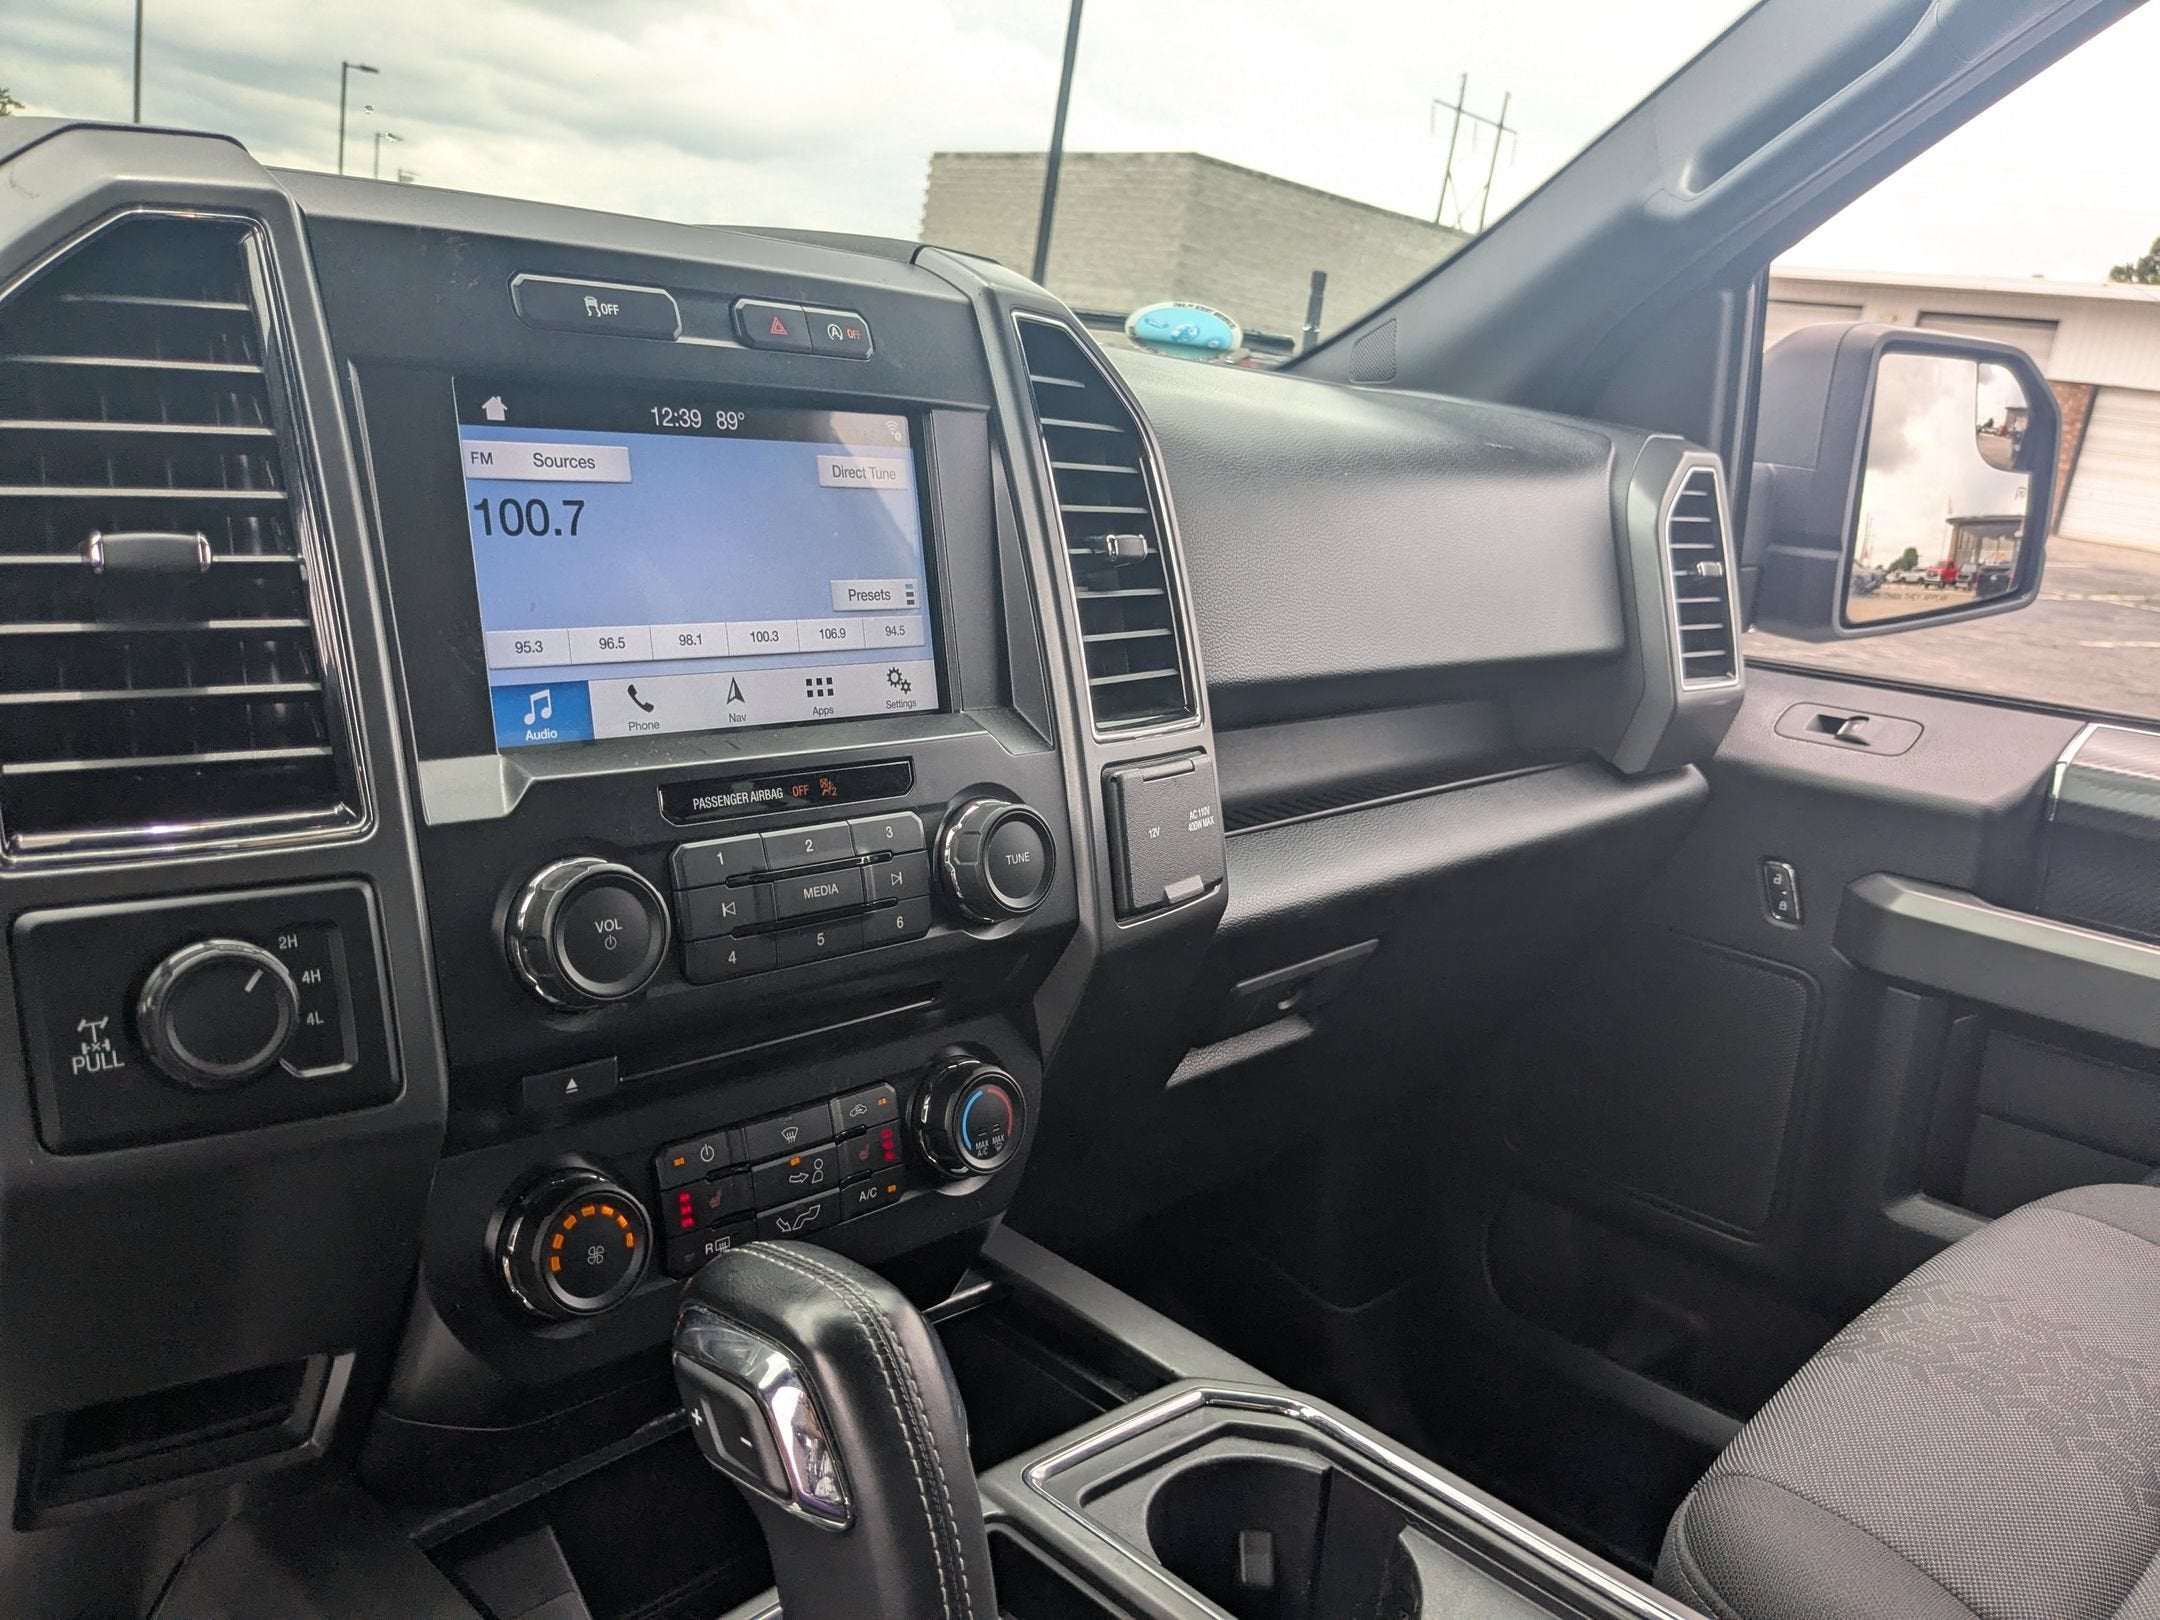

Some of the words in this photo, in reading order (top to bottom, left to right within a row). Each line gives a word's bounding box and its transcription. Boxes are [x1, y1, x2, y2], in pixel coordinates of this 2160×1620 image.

[600, 302, 619, 316] OFF
[846, 328, 862, 340] OFF
[651, 406, 702, 429] 12:39
[716, 409, 746, 431] 89°
[470, 450, 494, 466] FM
[533, 453, 596, 471] Sources
[831, 464, 867, 481] Direct
[868, 465, 897, 481] Tune
[474, 498, 585, 537] 100.7
[848, 588, 891, 604] Presets
[514, 640, 544, 655] 95.3
[599, 636, 626, 650] 96.5
[678, 633, 703, 647] 98.1
[750, 629, 780, 643] 100.3
[818, 626, 847, 640] 106.9
[885, 624, 906, 637] 94.5
[885, 696, 918, 711] Settings
[728, 712, 747, 724] Nav
[812, 704, 834, 719] Apps
[628, 719, 660, 733] Phone
[525, 727, 558, 741] Audio
[692, 791, 749, 810] PASSENGER
[750, 787, 784, 803] AIRBAG
[791, 784, 809, 798] OFF
[885, 825, 895, 838] 3
[1148, 826, 1161, 839] 12V
[804, 839, 814, 853] 2
[717, 852, 725, 866] 1
[1005, 850, 1031, 865] TUNE
[802, 882, 840, 900] MEDIA
[594, 918, 623, 934] VOL
[895, 915, 905, 929] 6
[278, 934, 299, 950] 2H
[816, 932, 826, 946] 5
[727, 950, 737, 965] 4
[302, 969, 322, 985] 4H
[306, 1011, 324, 1026] 4L
[72, 1051, 125, 1076] PULL
[975, 1139, 989, 1151] MAX
[858, 1187, 878, 1202] A/C
[704, 1242, 714, 1255] R
